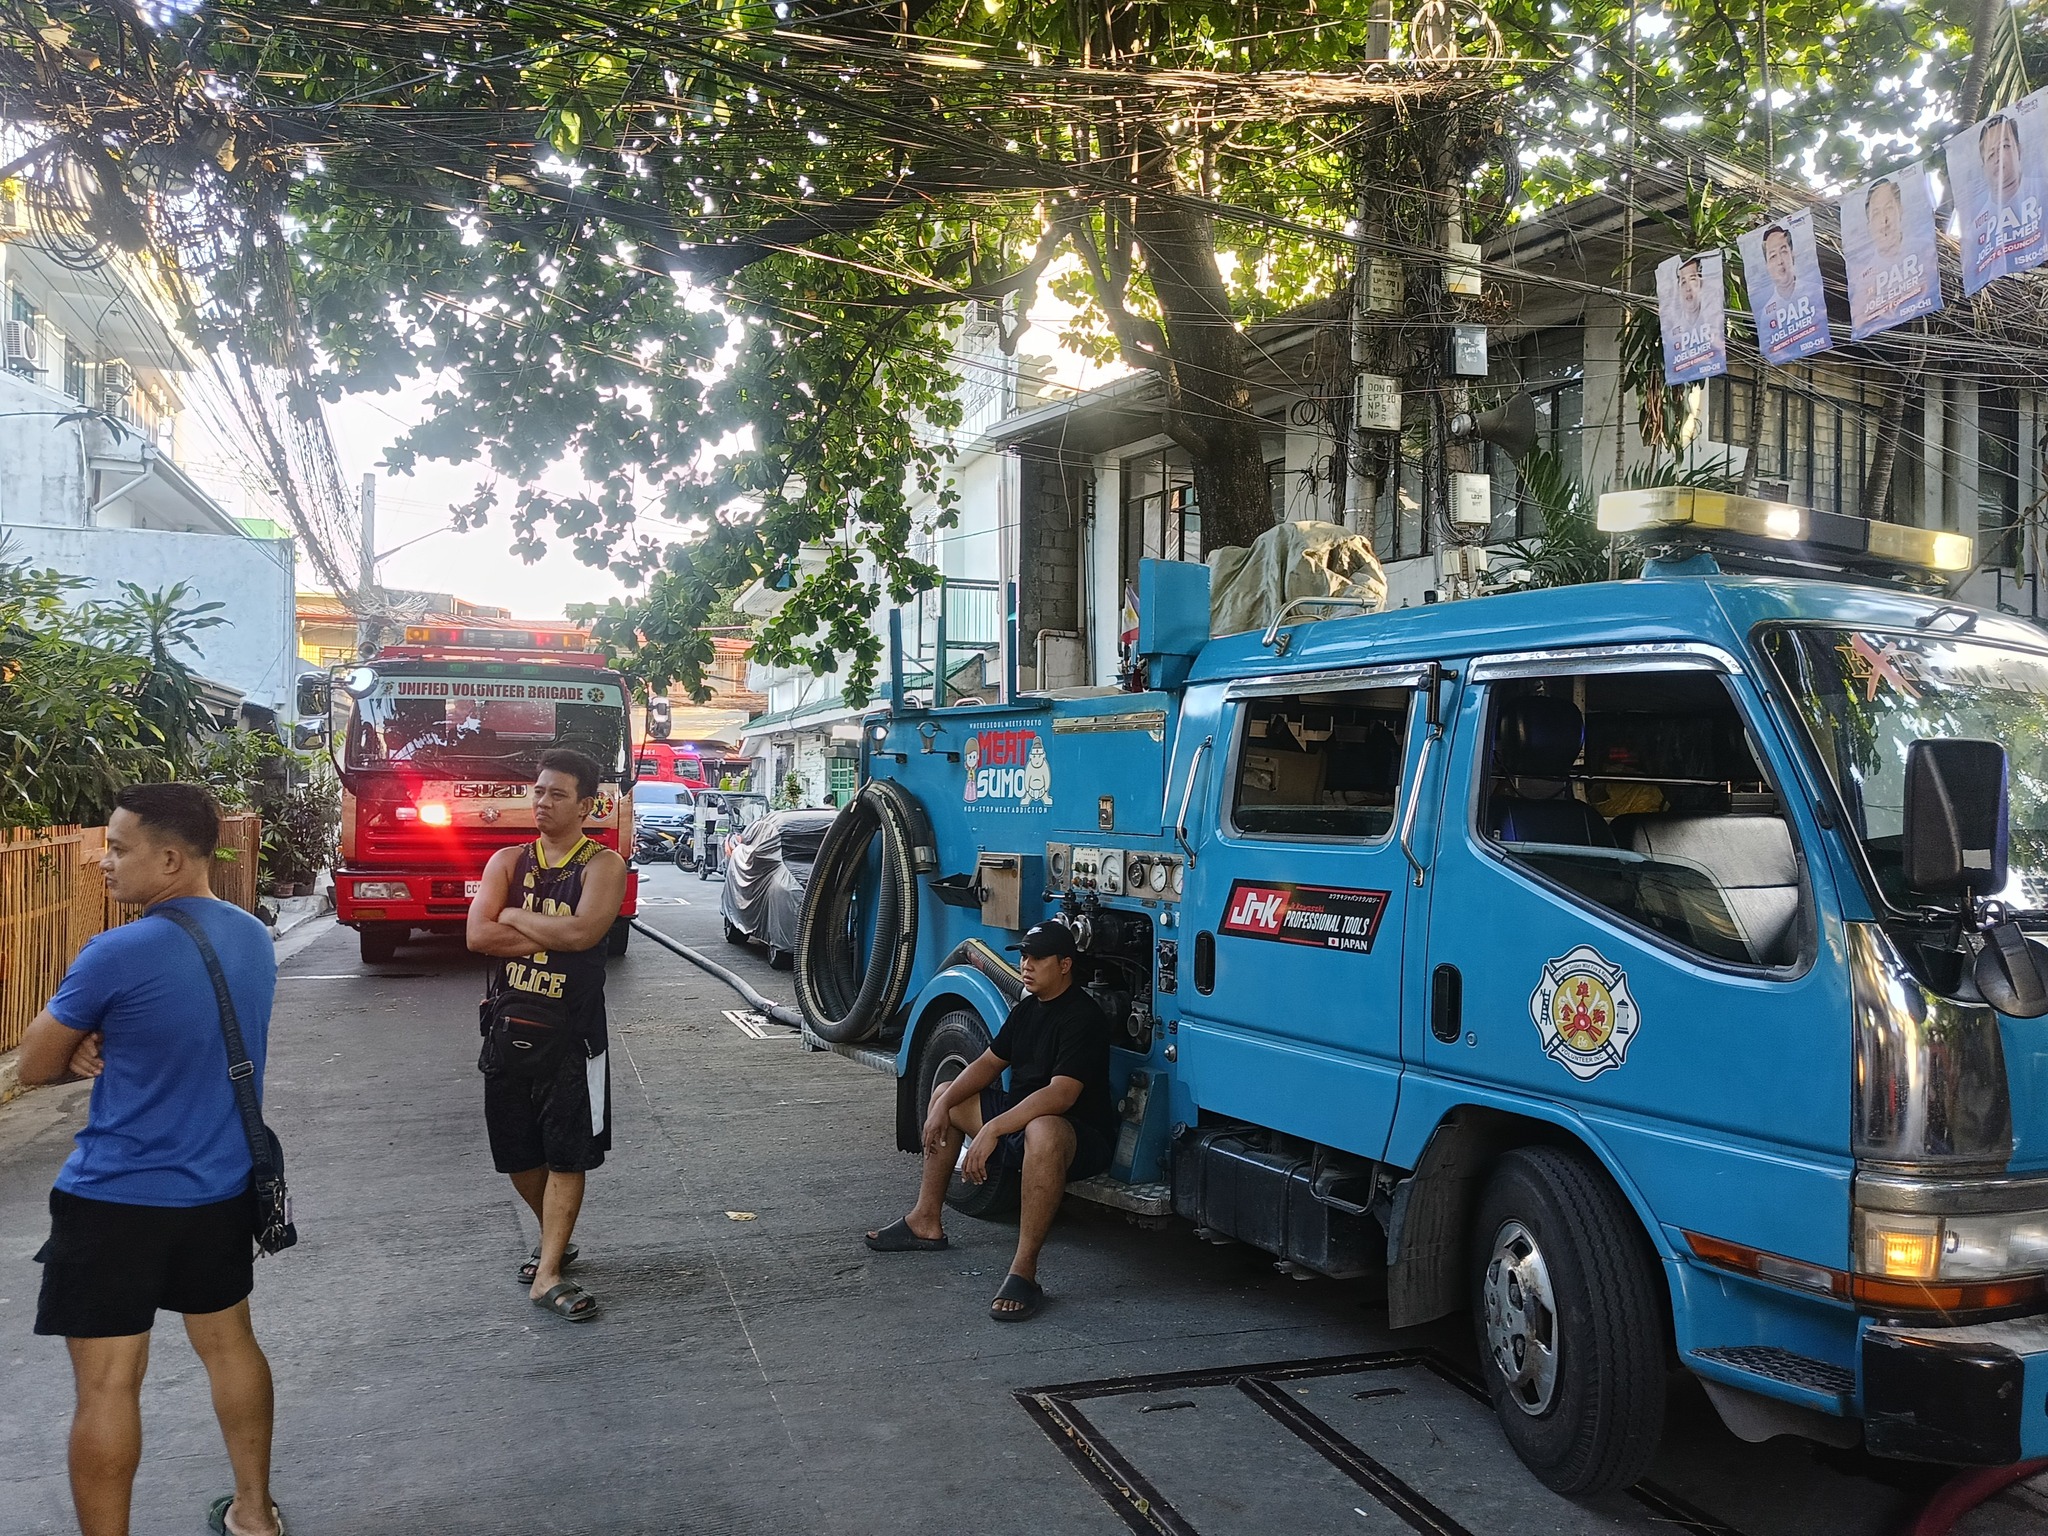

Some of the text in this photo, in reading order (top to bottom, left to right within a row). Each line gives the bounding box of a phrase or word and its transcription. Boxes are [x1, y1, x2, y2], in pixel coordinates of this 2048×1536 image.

[1986, 195, 2042, 244] PAR,
[1976, 220, 2039, 265] JOEL ELMER
[1876, 254, 1924, 296] PAR,
[1864, 276, 1919, 314] JOEL ELMER
[1777, 295, 1816, 330] PAR,
[1770, 316, 1812, 344] JOEL ELMER
[1673, 342, 1712, 365] JOEL ELMER
[398, 681, 583, 700] UNIFIED VOLUNTEER BRIGADE
[977, 729, 1036, 768] MEAT
[454, 784, 527, 798] ISUZU
[977, 768, 1026, 798] SUMO
[1011, 806, 1048, 814] ADDICTION
[1283, 910, 1370, 936] PROFESSIONAL TOOLS
[1340, 937, 1368, 950] JAPAN
[505, 961, 567, 999] OLICE
[1561, 1047, 1594, 1062] VOLUNTEER
